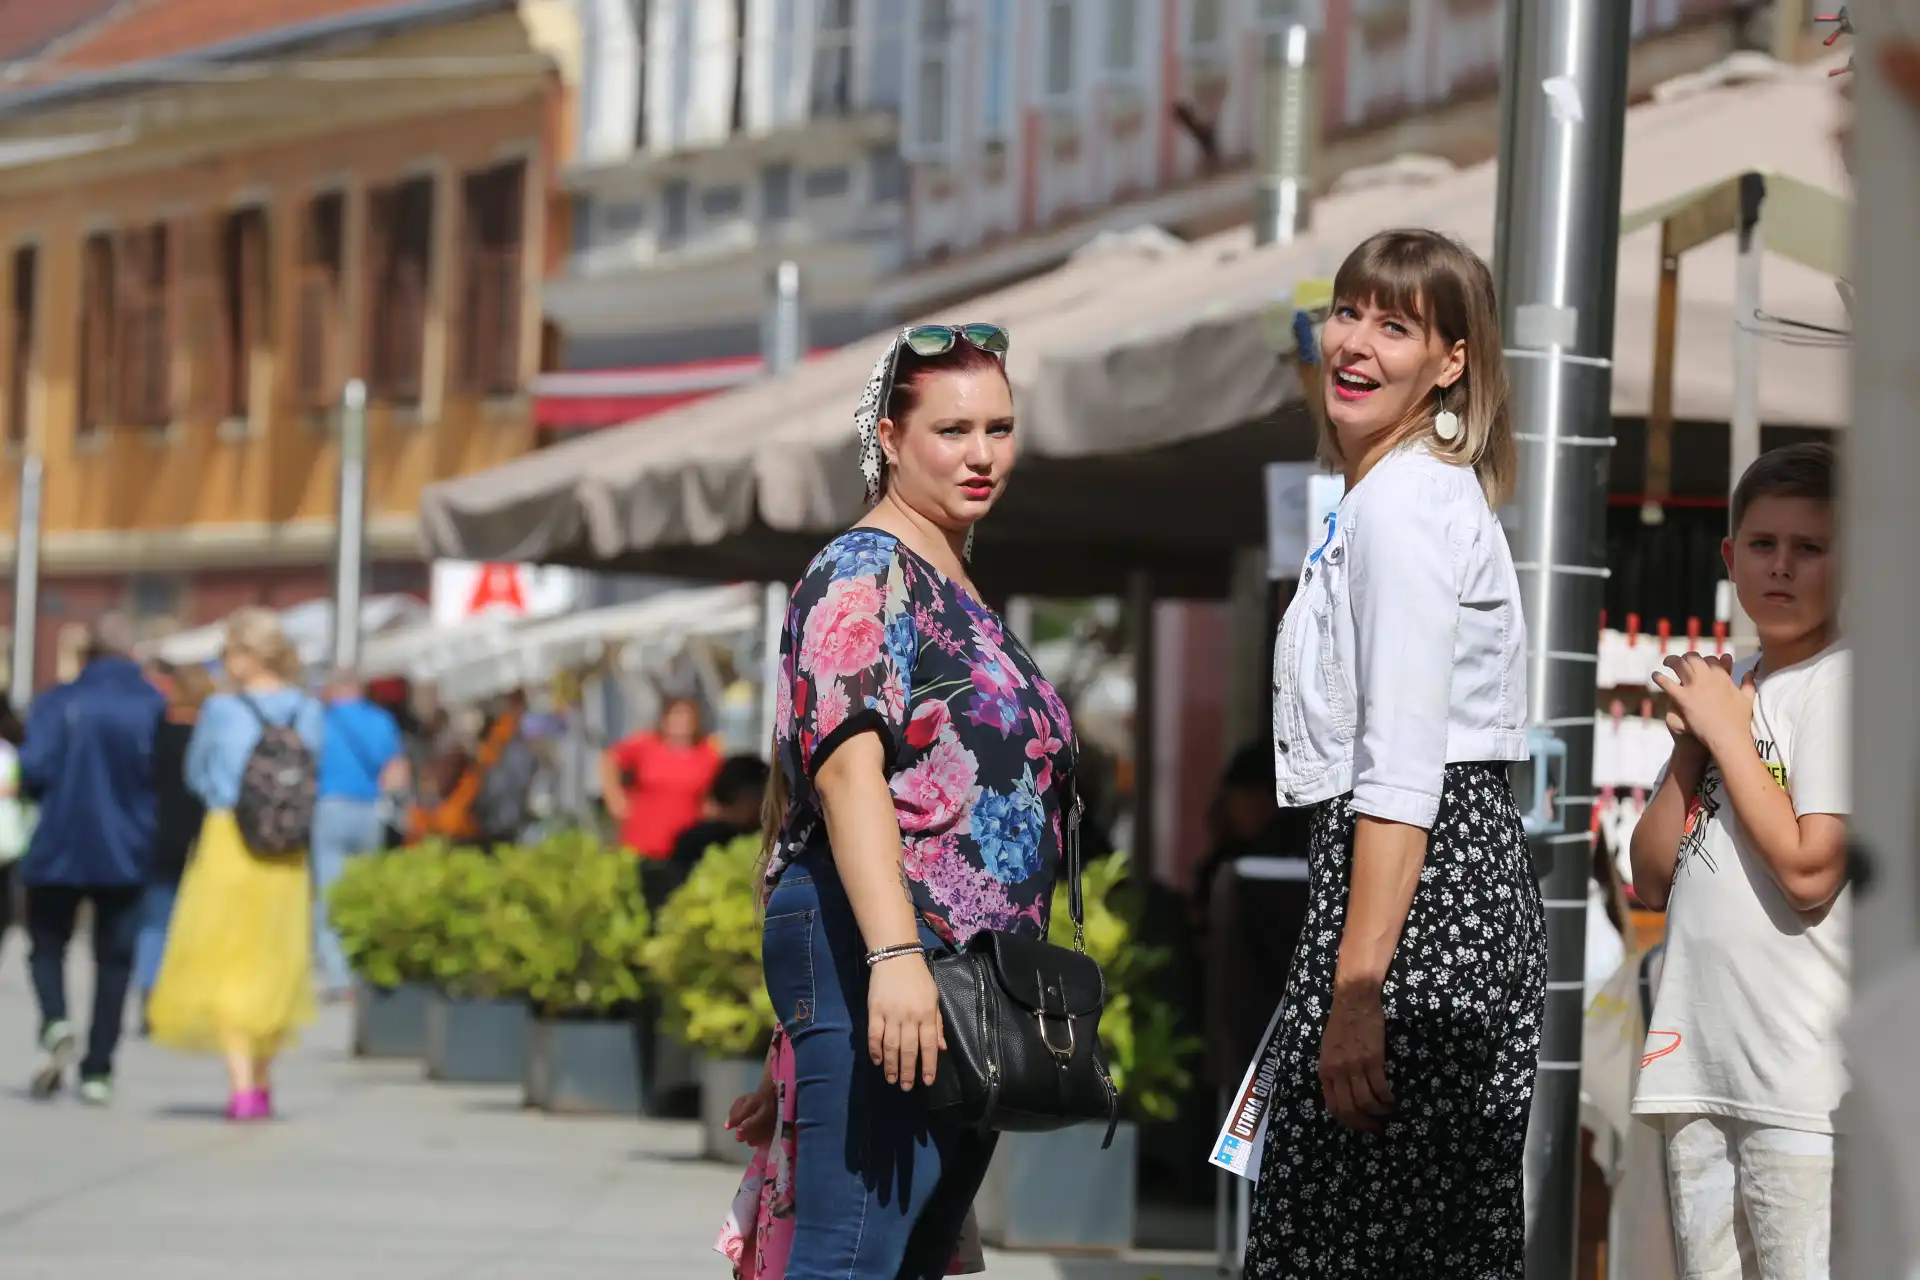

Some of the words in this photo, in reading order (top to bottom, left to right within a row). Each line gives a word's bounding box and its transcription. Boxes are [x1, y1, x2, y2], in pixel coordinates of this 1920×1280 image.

[1755, 739, 1775, 760] OY
[1234, 1097, 1264, 1137] UTRKA
[1251, 1057, 1276, 1098] GRADA
